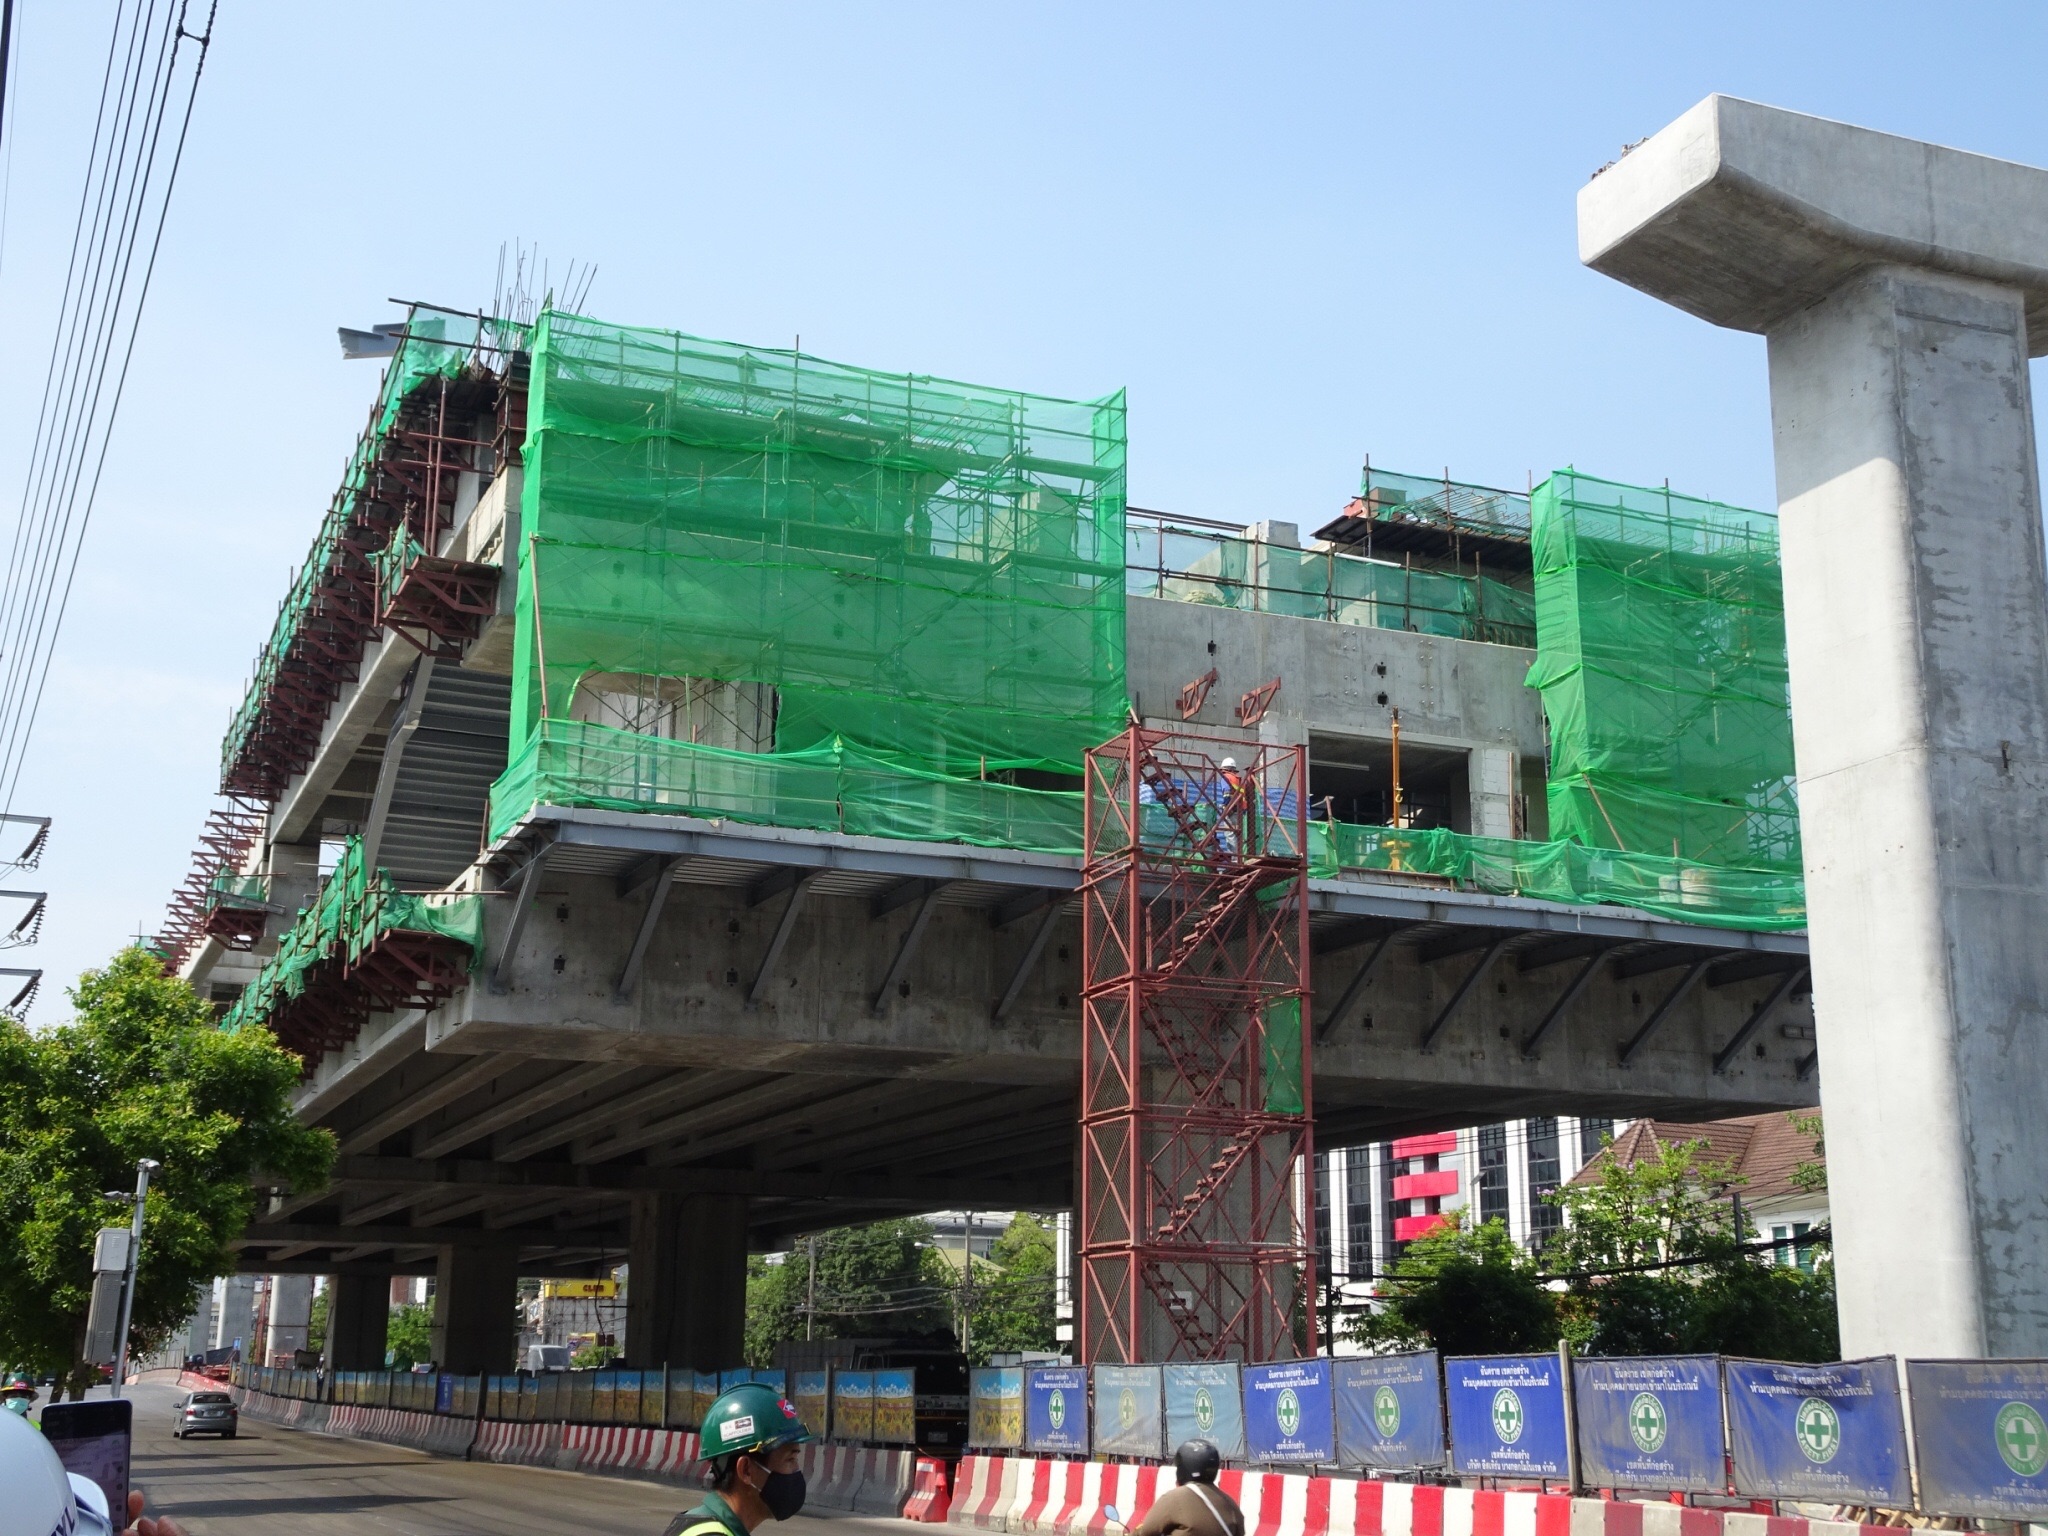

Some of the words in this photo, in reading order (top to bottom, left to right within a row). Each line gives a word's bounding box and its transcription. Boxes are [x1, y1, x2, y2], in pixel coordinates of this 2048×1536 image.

[1632, 1426, 1650, 1450] SAFETY
[1651, 1431, 1664, 1450] FIRST
[1799, 1432, 1821, 1461] SAFETY
[1822, 1438, 1839, 1459] FIRST
